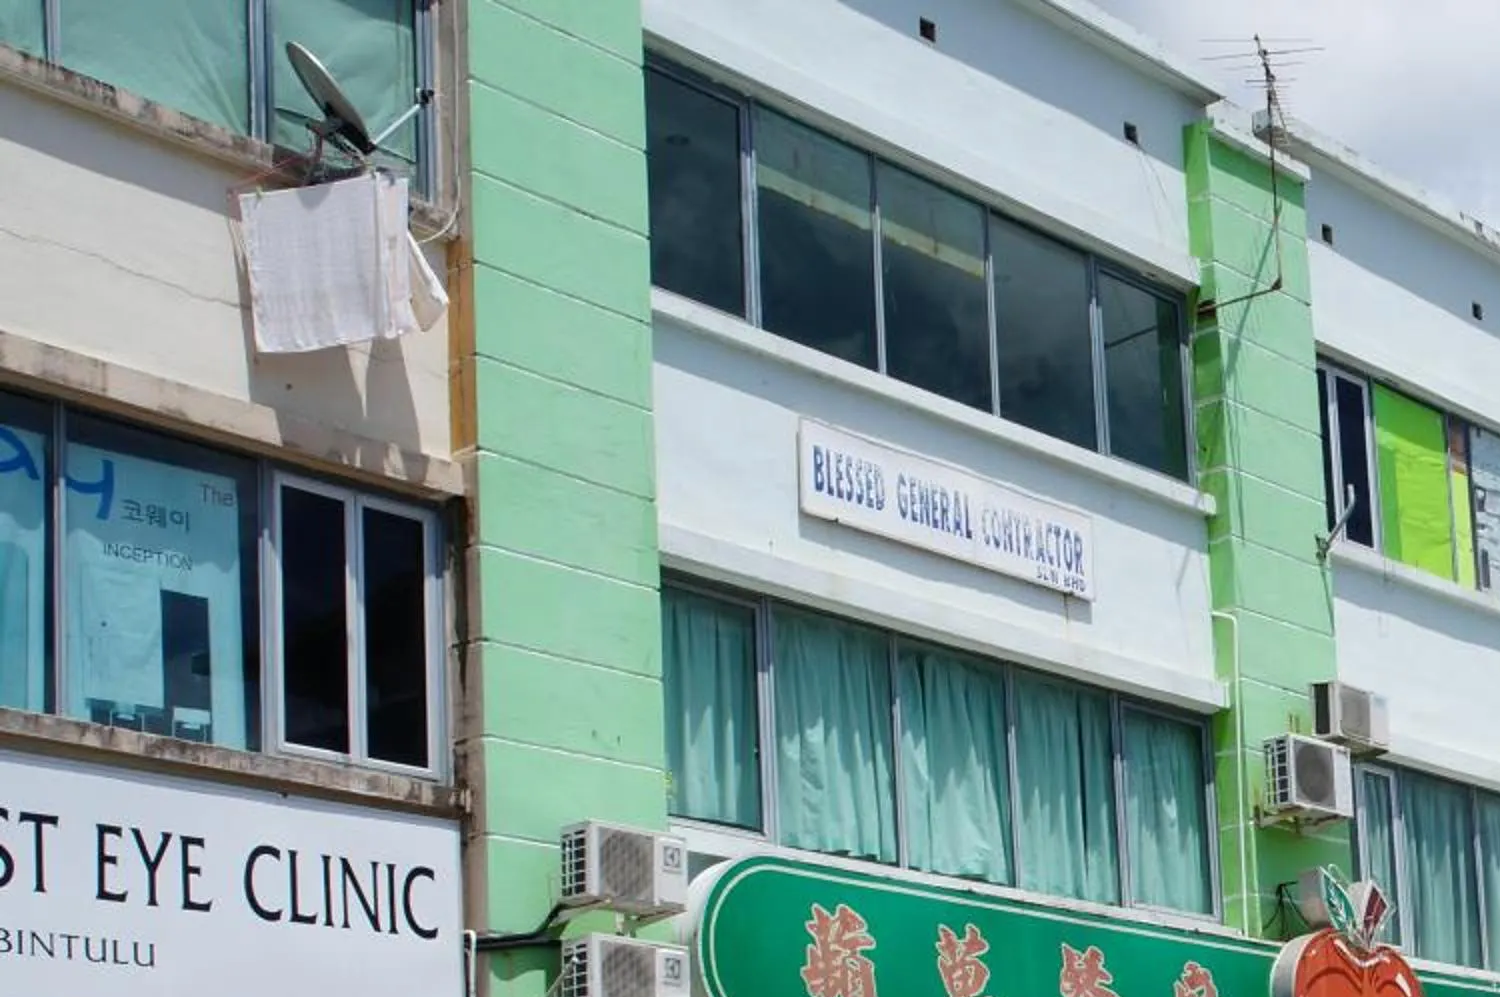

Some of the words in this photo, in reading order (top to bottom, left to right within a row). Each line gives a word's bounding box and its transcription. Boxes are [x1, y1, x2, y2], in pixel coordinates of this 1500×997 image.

[812, 445, 885, 511] BLESSED
[896, 471, 973, 540] GENERAL
[981, 507, 1085, 576] CONTRACTOR
[102, 542, 193, 573] INCEPTION
[95, 823, 213, 913] EYE
[243, 845, 439, 940] CLINIC
[0, 928, 156, 968] BINTULU
